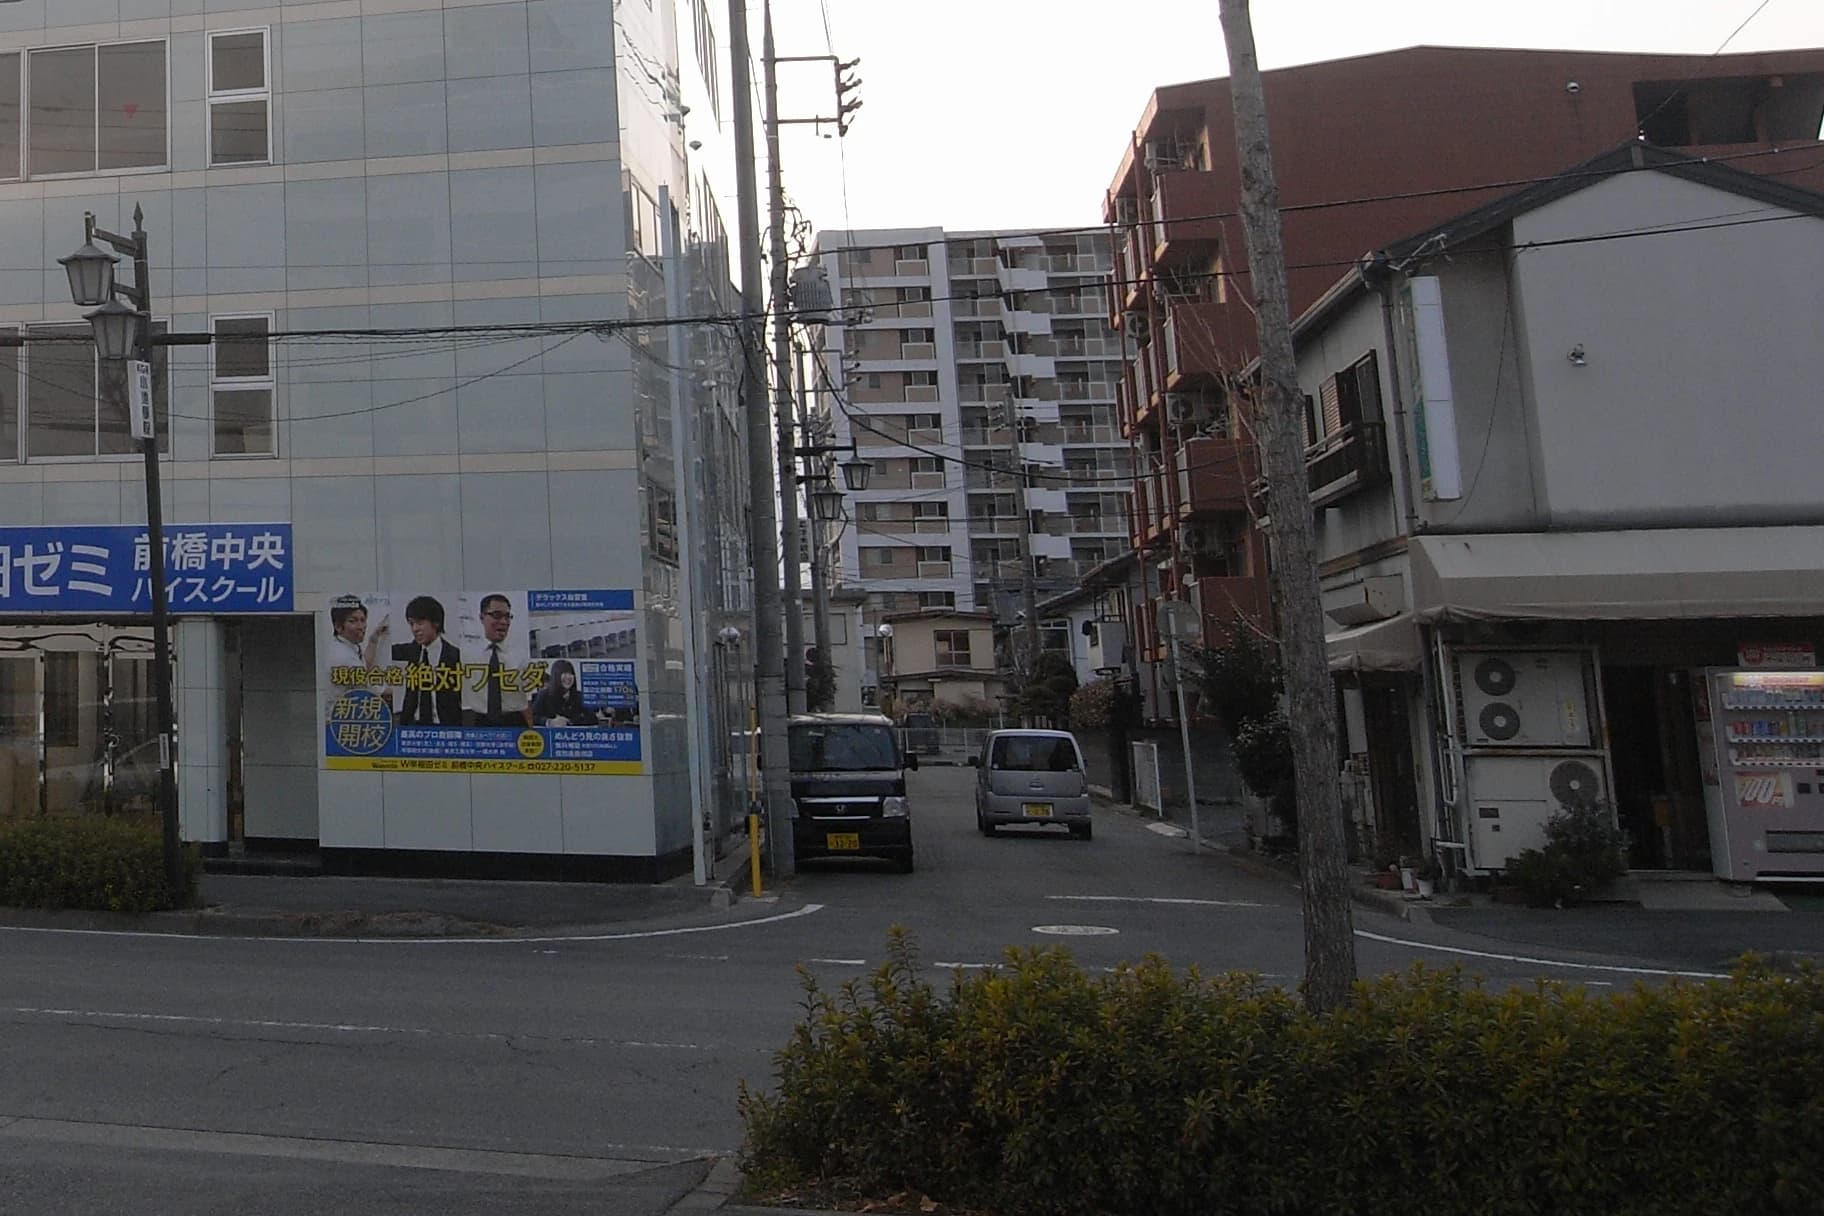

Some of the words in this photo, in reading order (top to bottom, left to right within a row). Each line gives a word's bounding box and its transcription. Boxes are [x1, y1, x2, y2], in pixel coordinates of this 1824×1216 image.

[133, 532, 286, 573] 前橋中央
[131, 575, 285, 604] ハイスクール
[332, 666, 403, 687] 現役合格
[405, 661, 549, 692] 絶対ワセダ
[335, 695, 382, 720] 新規
[337, 724, 386, 748] 開校
